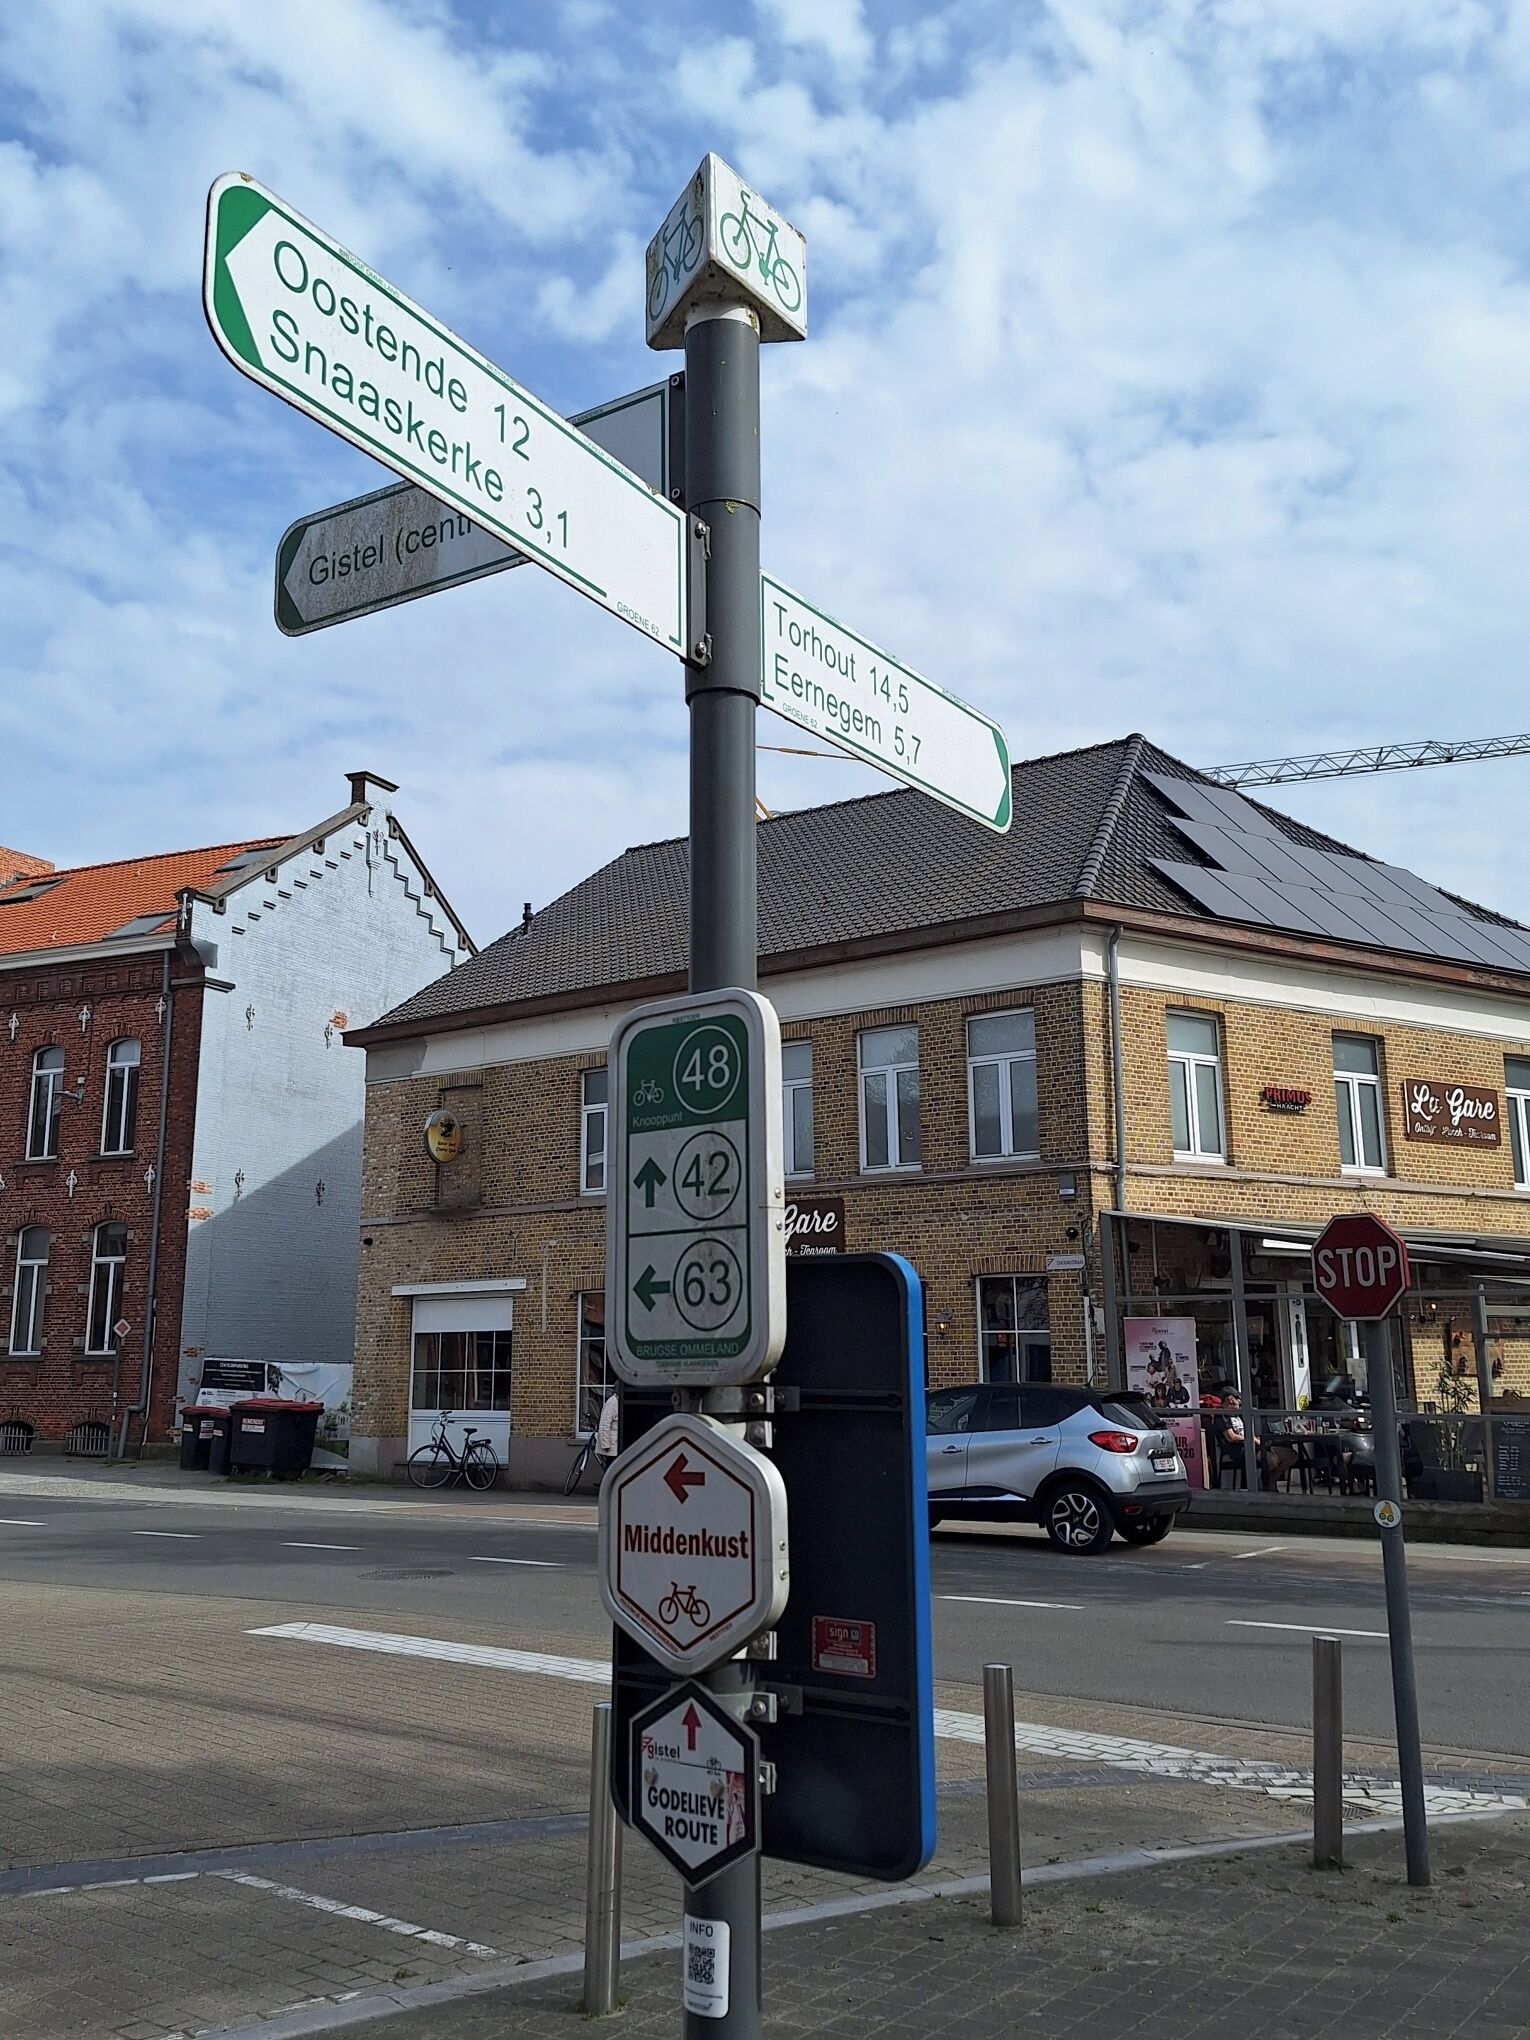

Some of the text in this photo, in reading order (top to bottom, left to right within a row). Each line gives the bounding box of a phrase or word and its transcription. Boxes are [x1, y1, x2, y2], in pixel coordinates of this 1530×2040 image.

[273, 240, 530, 462] Oostende 12
[270, 309, 569, 549] Snaaskerke 3,1
[309, 534, 384, 586] Gistel
[617, 601, 650, 631] GROENE
[773, 601, 857, 683] Torhout
[869, 666, 909, 715] 14,5
[774, 653, 922, 766] Eernegem 5,7
[681, 1044, 731, 1091] 48
[1264, 1087, 1312, 1105] PRIMUS
[1445, 1088, 1496, 1127] Gare
[633, 1111, 683, 1127] Knooppunt
[681, 1150, 731, 1197] 42
[784, 1203, 838, 1246] Gare
[800, 1244, 838, 1256] Tearoom
[1317, 1245, 1397, 1289] STOP
[683, 1260, 731, 1307] 63
[636, 1342, 739, 1356] BRUGSE OMMELAND
[624, 1524, 749, 1559] Middenkust
[829, 1623, 849, 1641] sign
[647, 1741, 680, 1760] gistel
[647, 1785, 725, 1820] GODELIEVE
[664, 1815, 718, 1846] ROUTE
[689, 1921, 714, 1938] INFO
